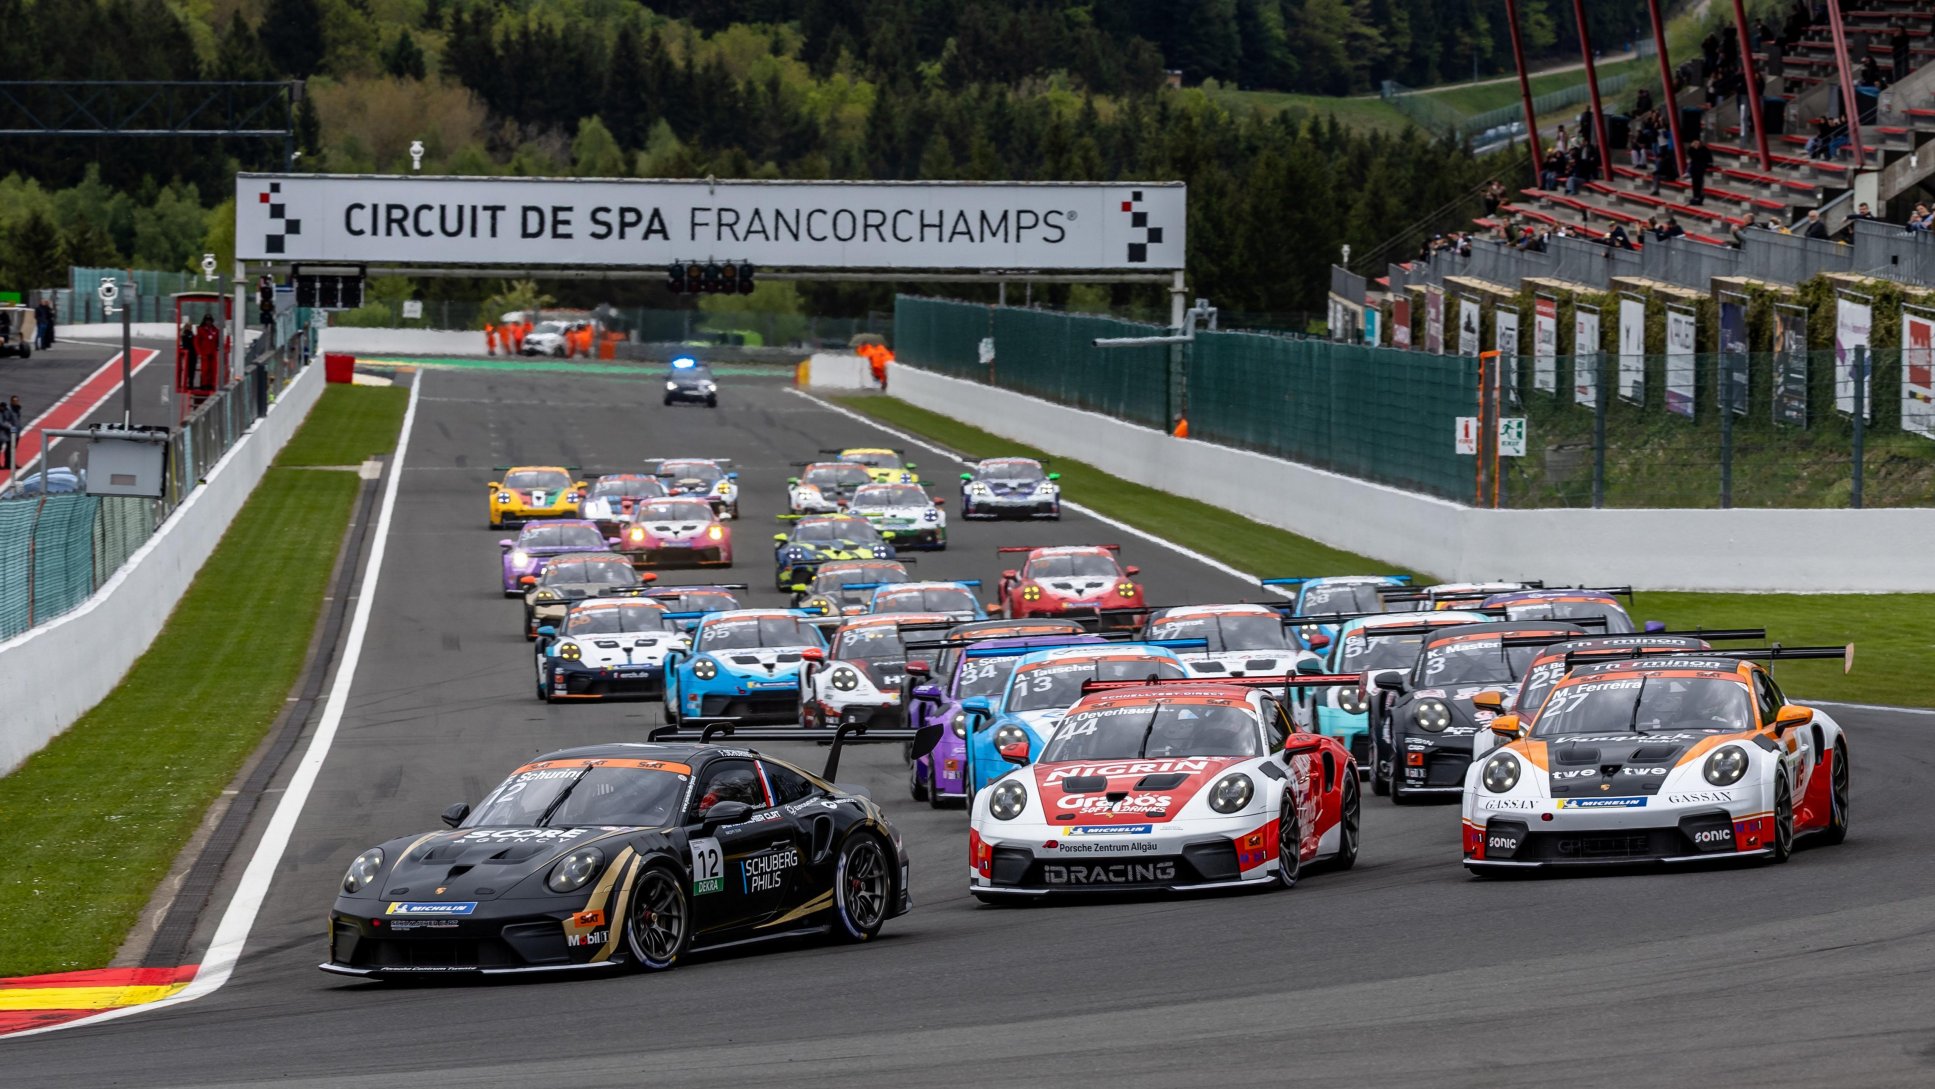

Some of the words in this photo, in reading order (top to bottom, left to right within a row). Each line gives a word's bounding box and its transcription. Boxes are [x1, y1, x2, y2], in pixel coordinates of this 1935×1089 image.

[345, 203, 506, 238] CIRCUIT
[521, 206, 574, 239] DE
[589, 207, 670, 241] SPA
[703, 628, 730, 641] 95
[1427, 649, 1442, 659] K.
[960, 665, 997, 685] 34
[1015, 673, 1030, 683] A.
[1031, 664, 1096, 677] Tauscher
[1426, 657, 1445, 675] 3
[1014, 676, 1053, 697] 13
[1529, 667, 1566, 690] 25
[1552, 690, 1570, 699] M.
[1576, 680, 1642, 694] Ferreira
[1542, 693, 1589, 719] 27
[1064, 716, 1076, 725] T.
[1077, 707, 1156, 721] Oeverhaus
[1055, 718, 1097, 741] 44
[1045, 761, 1209, 783] NIGRIN
[485, 783, 527, 807] 12
[1668, 791, 1733, 804] GASSAN
[1121, 805, 1168, 813] DRINKS
[1486, 799, 1538, 810] GASSAN
[464, 829, 589, 839] SCORE
[1087, 826, 1145, 834] MICHELIN
[453, 836, 571, 844] AGENCY
[1059, 843, 1092, 853] Porsche
[1094, 843, 1129, 852] Zentrum
[1131, 842, 1157, 853] Allgäu
[698, 849, 718, 879] 12
[745, 850, 798, 876] SCHUBERG
[698, 880, 719, 893] DEKRA
[751, 871, 781, 893] PHILIS
[410, 904, 467, 912] MICHELIN
[568, 933, 600, 947] Mobil
